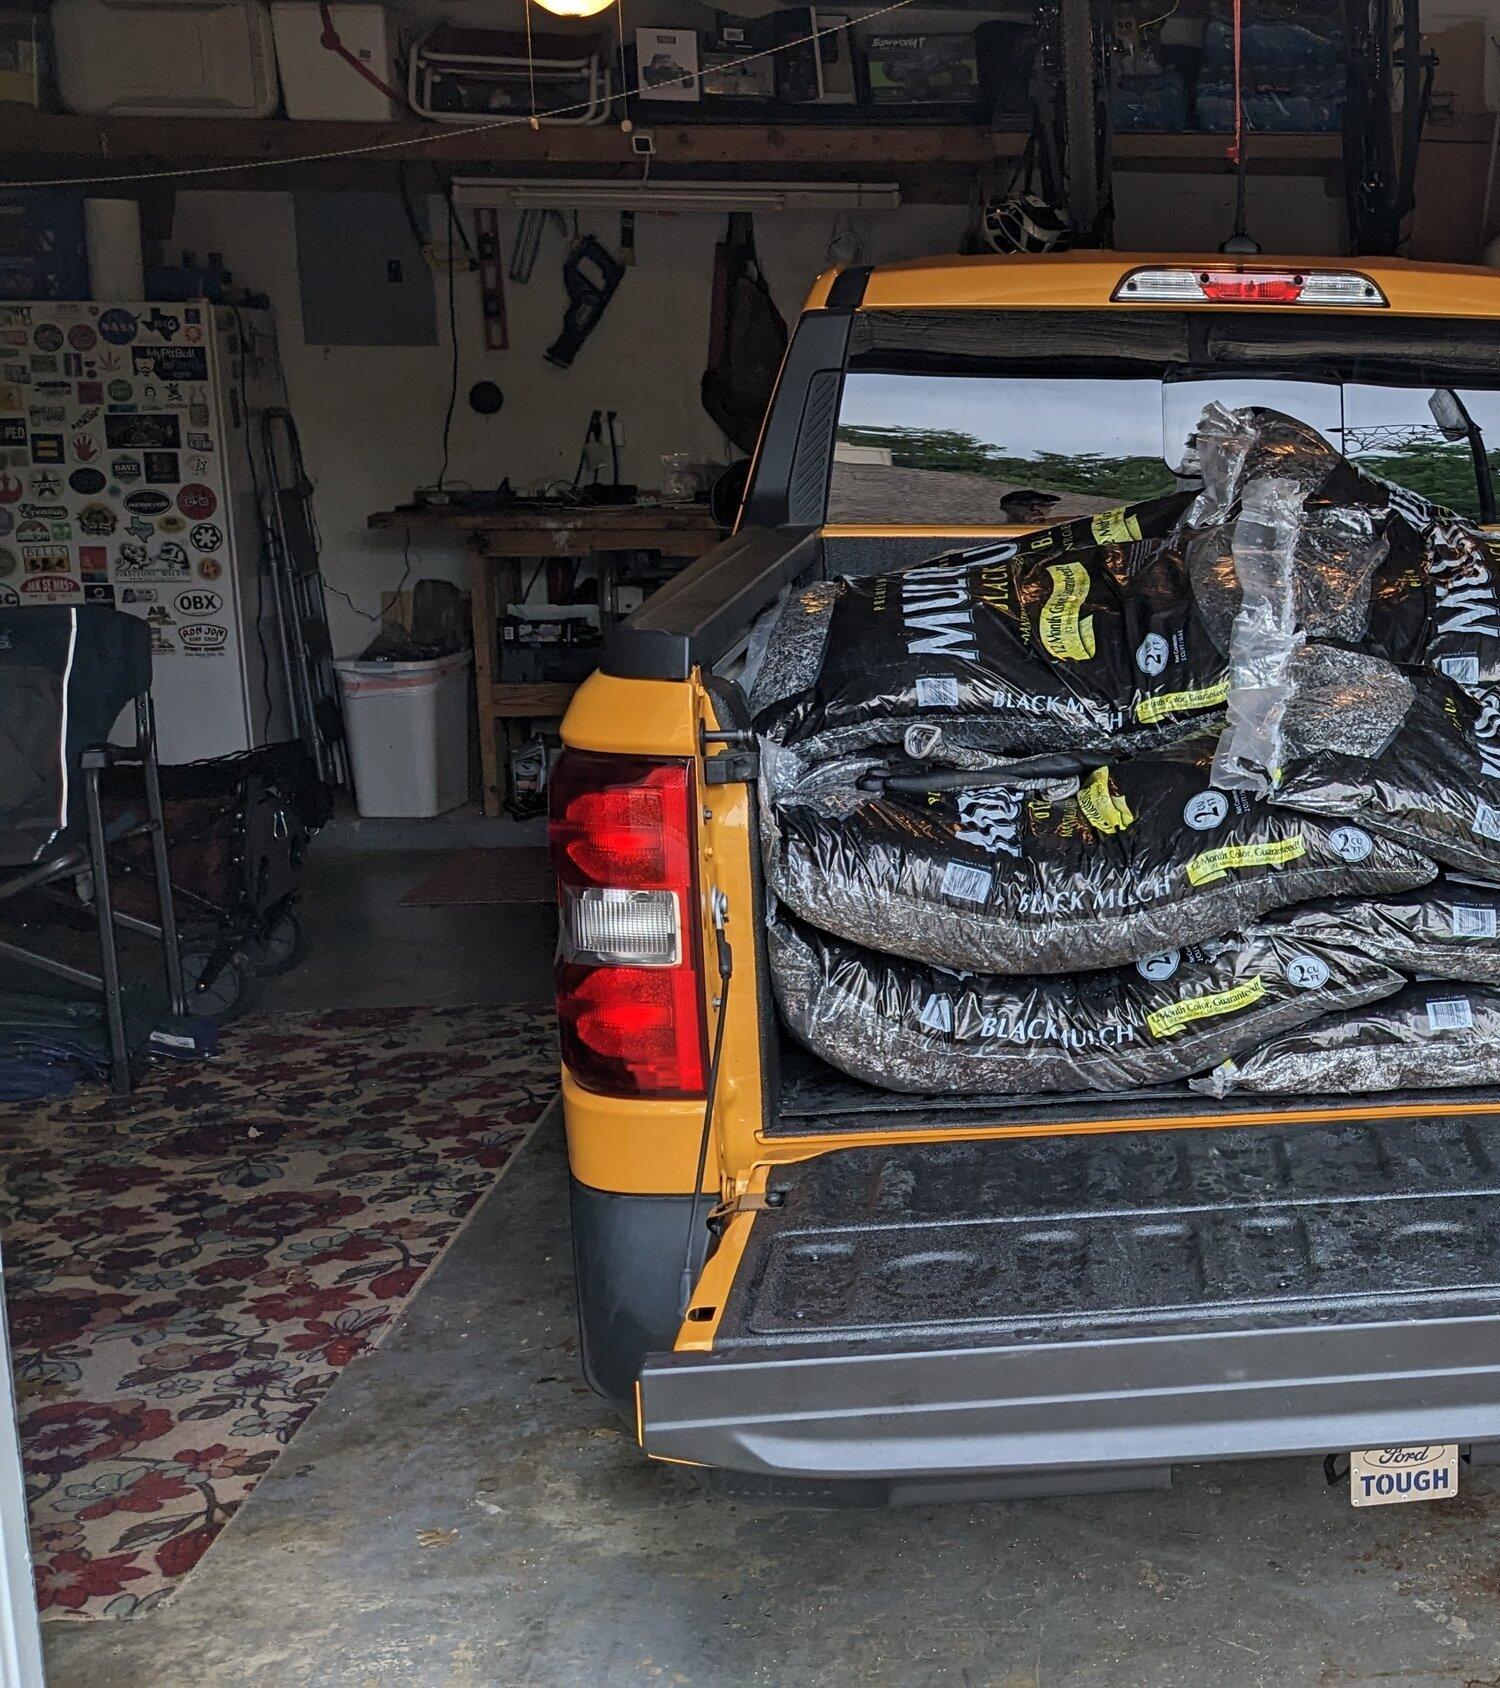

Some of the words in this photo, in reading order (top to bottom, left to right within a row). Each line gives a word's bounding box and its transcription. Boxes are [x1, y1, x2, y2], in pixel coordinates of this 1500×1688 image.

[179, 594, 217, 610] OBX
[182, 626, 202, 638] RON
[203, 626, 225, 637] JON
[1145, 653, 1162, 666] 2
[992, 690, 1053, 713] BLACK
[1194, 807, 1220, 823] 2
[1197, 801, 1207, 813] CU
[1338, 833, 1351, 853] 2
[1351, 837, 1363, 845] CU
[1351, 846, 1362, 854] FT
[1200, 852, 1228, 865] Month
[1229, 848, 1253, 860] Color,
[1254, 840, 1301, 858] Guaranteed!
[1018, 889, 1085, 914] BLACK
[1146, 953, 1172, 972] 2
[1306, 966, 1320, 975] CU
[1293, 964, 1307, 982] 2
[1310, 974, 1321, 982] FT
[1158, 1006, 1187, 1021] Month
[1187, 1000, 1213, 1013] Color,
[1213, 981, 1261, 1006] Guaranteed!
[980, 1017, 1058, 1039] BLACK
[1378, 1446, 1430, 1465] Ford
[1360, 1467, 1449, 1497] TOUGH
